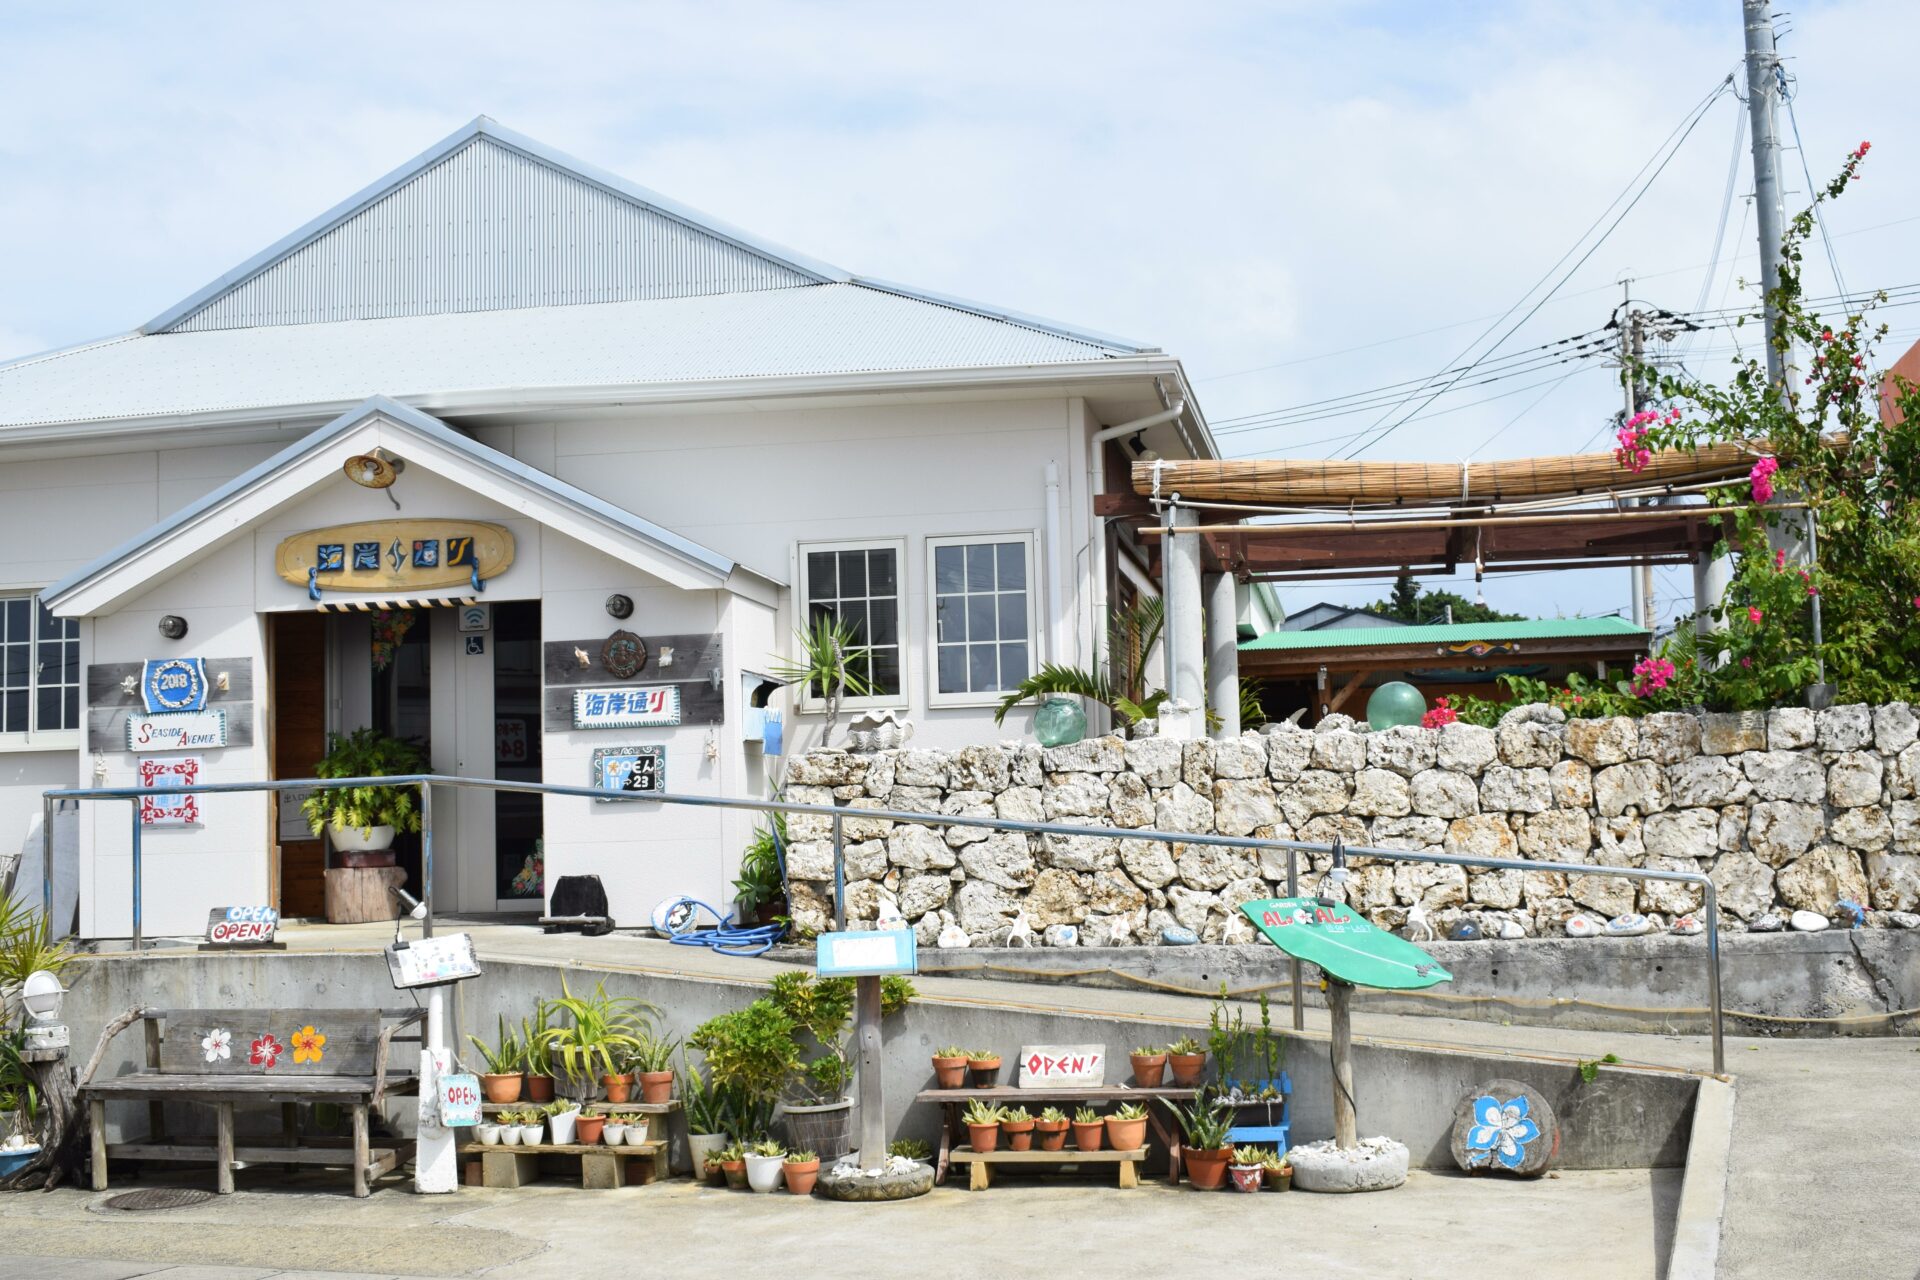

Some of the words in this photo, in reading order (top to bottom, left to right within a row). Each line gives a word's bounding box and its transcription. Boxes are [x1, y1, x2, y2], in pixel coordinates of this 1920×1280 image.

[161, 674, 188, 690] 2018
[585, 691, 665, 716] 海岸通り
[633, 776, 649, 788] 23
[230, 906, 277, 921] OPEN
[214, 923, 271, 939] OPEN!
[1027, 1054, 1099, 1076] OPEN!
